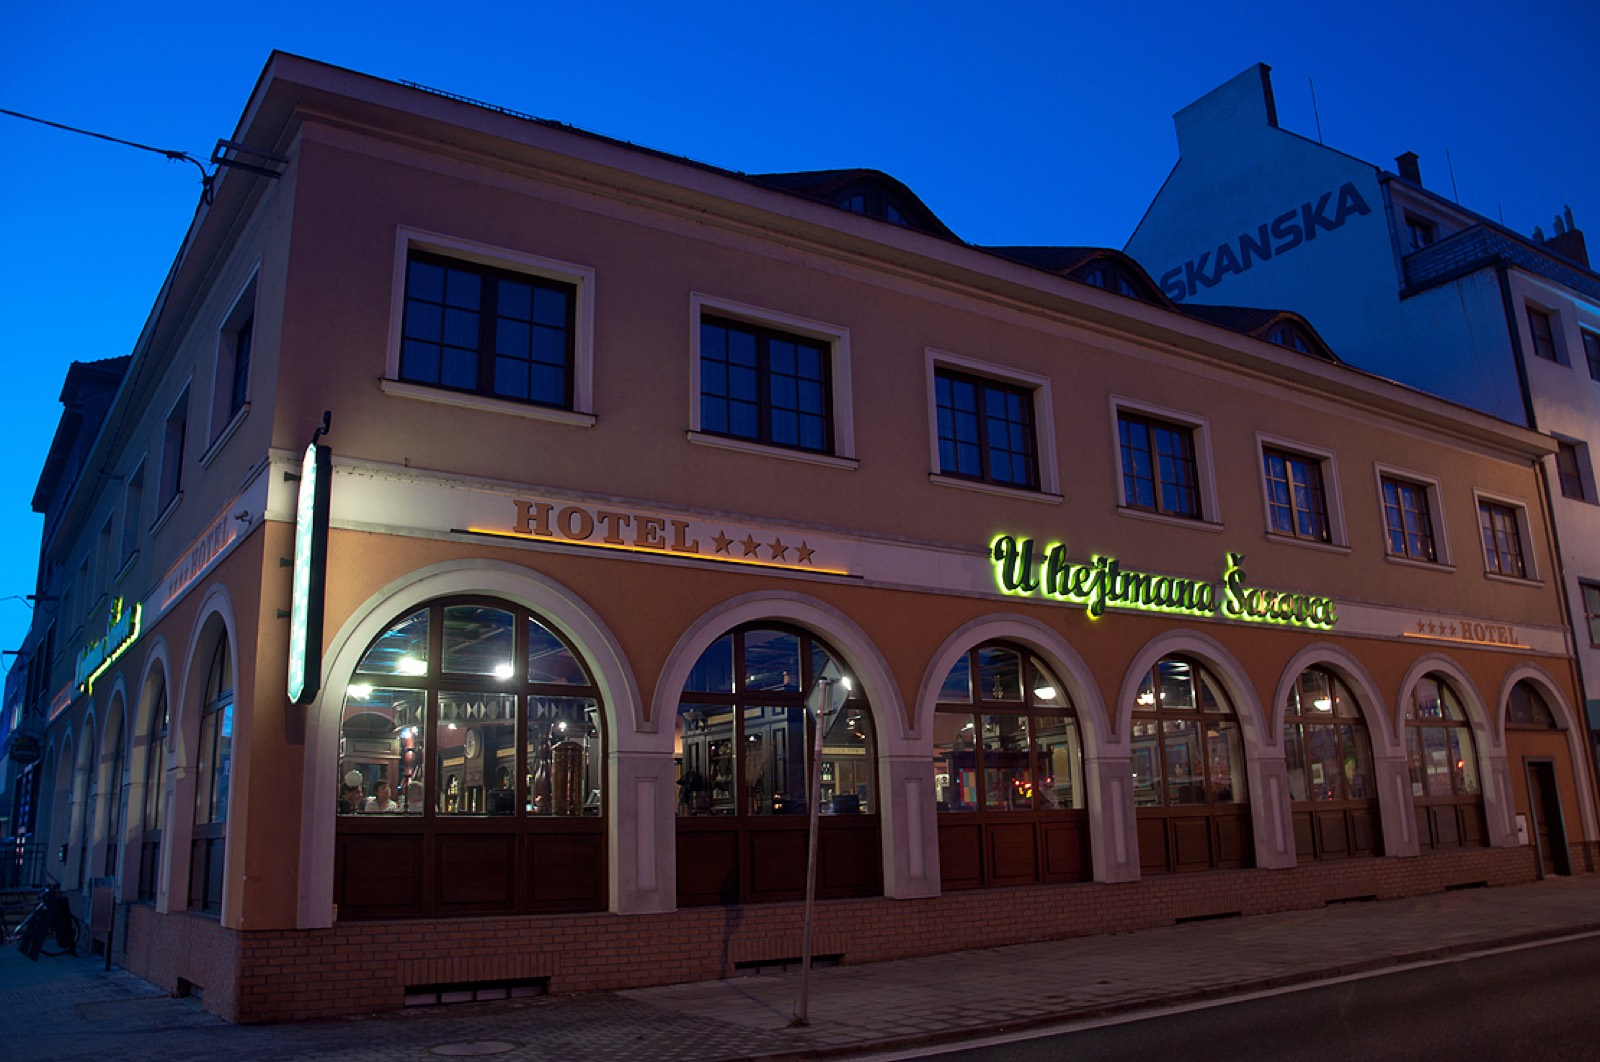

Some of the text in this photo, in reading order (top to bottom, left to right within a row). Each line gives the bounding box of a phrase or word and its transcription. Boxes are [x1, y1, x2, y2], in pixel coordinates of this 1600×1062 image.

[1159, 181, 1372, 301] SKANSKA
[512, 500, 699, 553] HOTEL
[991, 535, 1039, 592] U
[1042, 543, 1219, 618] hejtmana
[1459, 620, 1519, 645] HOTEL
